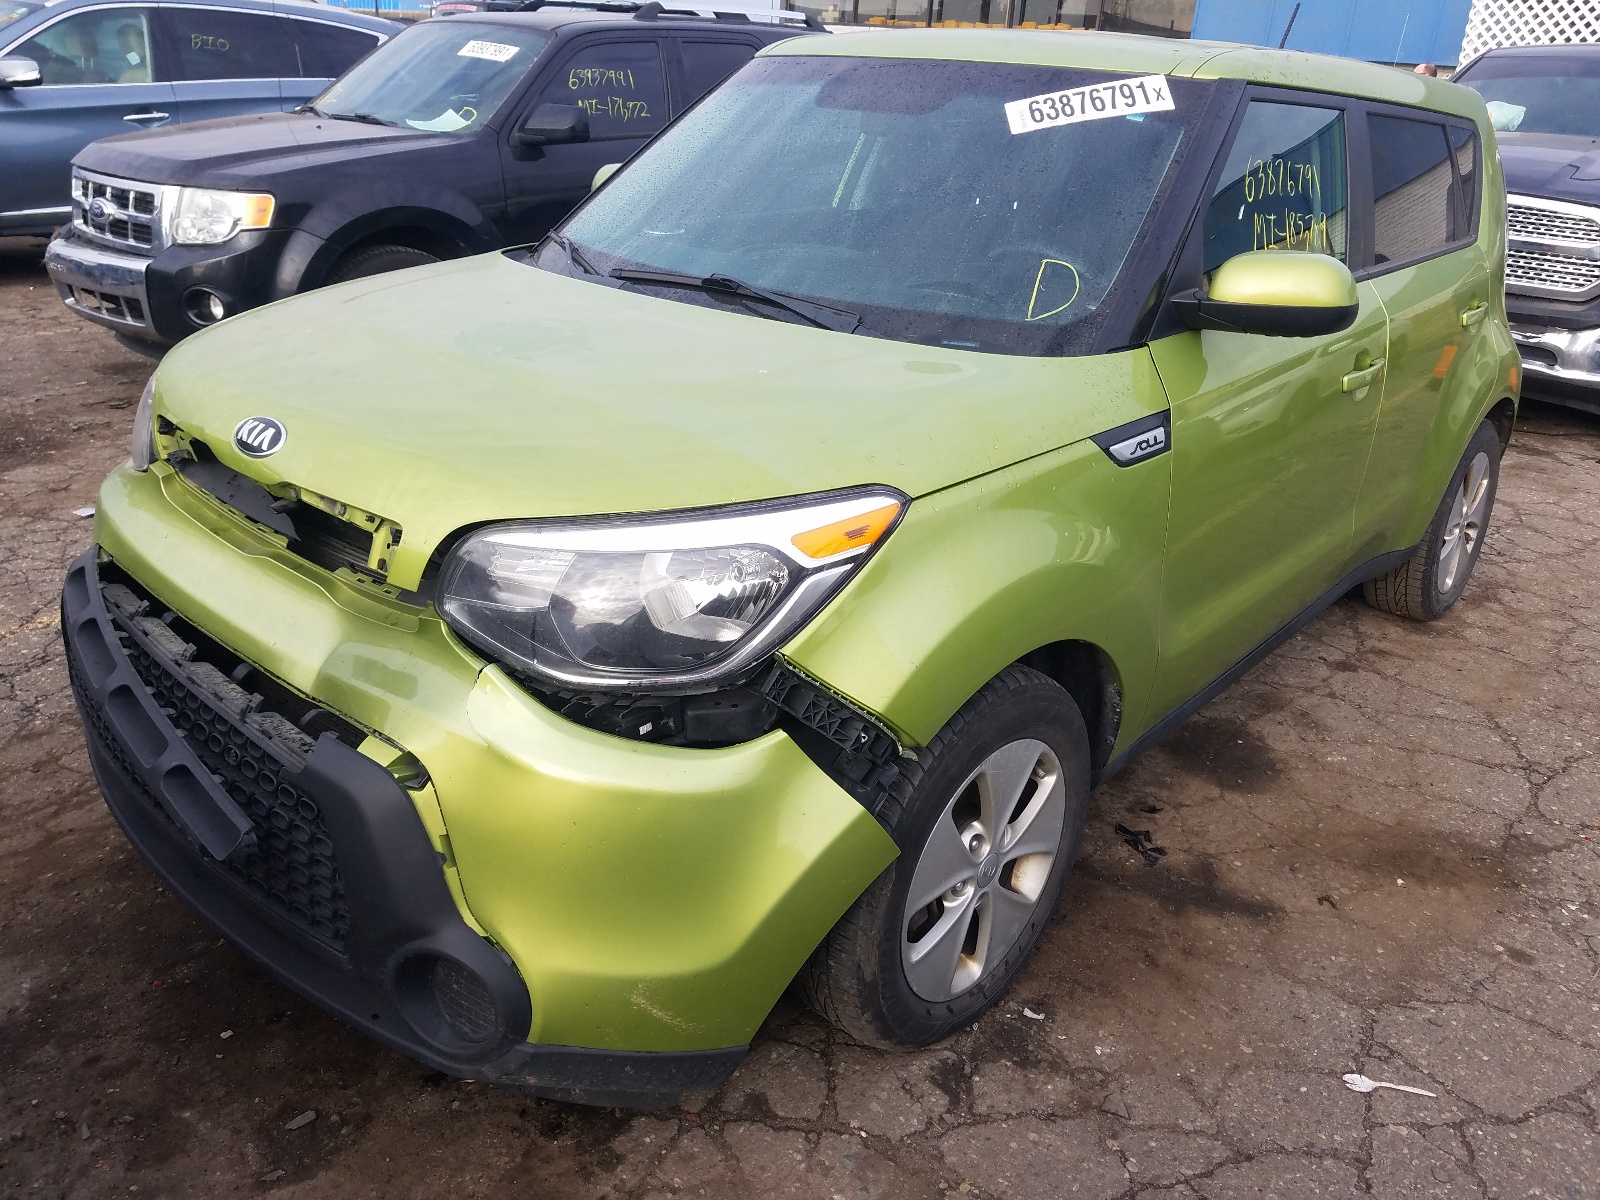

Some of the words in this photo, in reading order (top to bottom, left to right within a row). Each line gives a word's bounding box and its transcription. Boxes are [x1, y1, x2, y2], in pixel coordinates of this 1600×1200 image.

[568, 68, 635, 90] 63937991
[1028, 80, 1151, 124] 63876791
[1245, 155, 1321, 203] 63876791
[1024, 258, 1080, 321] D
[236, 419, 276, 452] KIA
